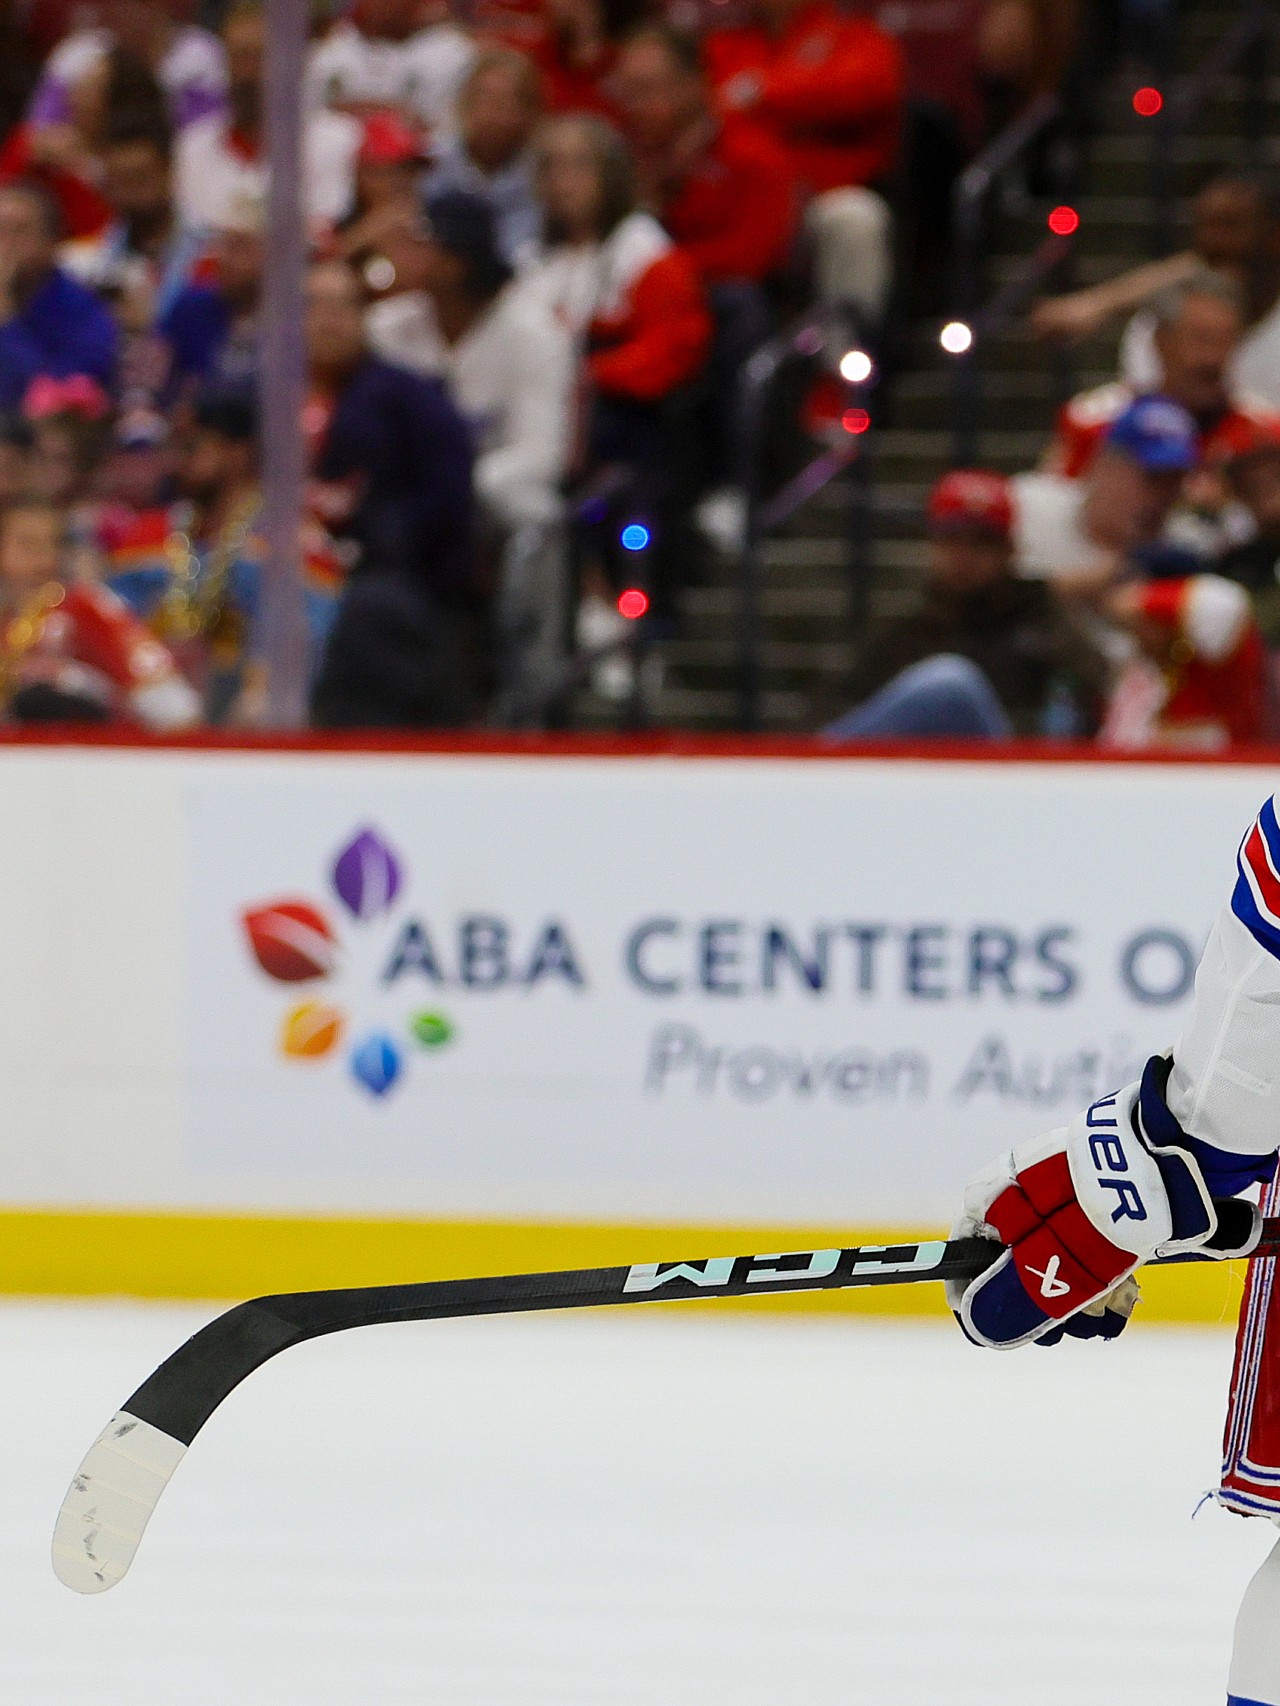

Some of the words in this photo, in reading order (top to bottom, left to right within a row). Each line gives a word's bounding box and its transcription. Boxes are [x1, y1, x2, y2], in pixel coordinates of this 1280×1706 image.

[379, 914, 585, 990] ABA
[623, 917, 1077, 1003] CENTERS
[644, 1022, 930, 1105] Proven
[1086, 1089, 1148, 1224] UER
[622, 1240, 948, 1293] CCM
